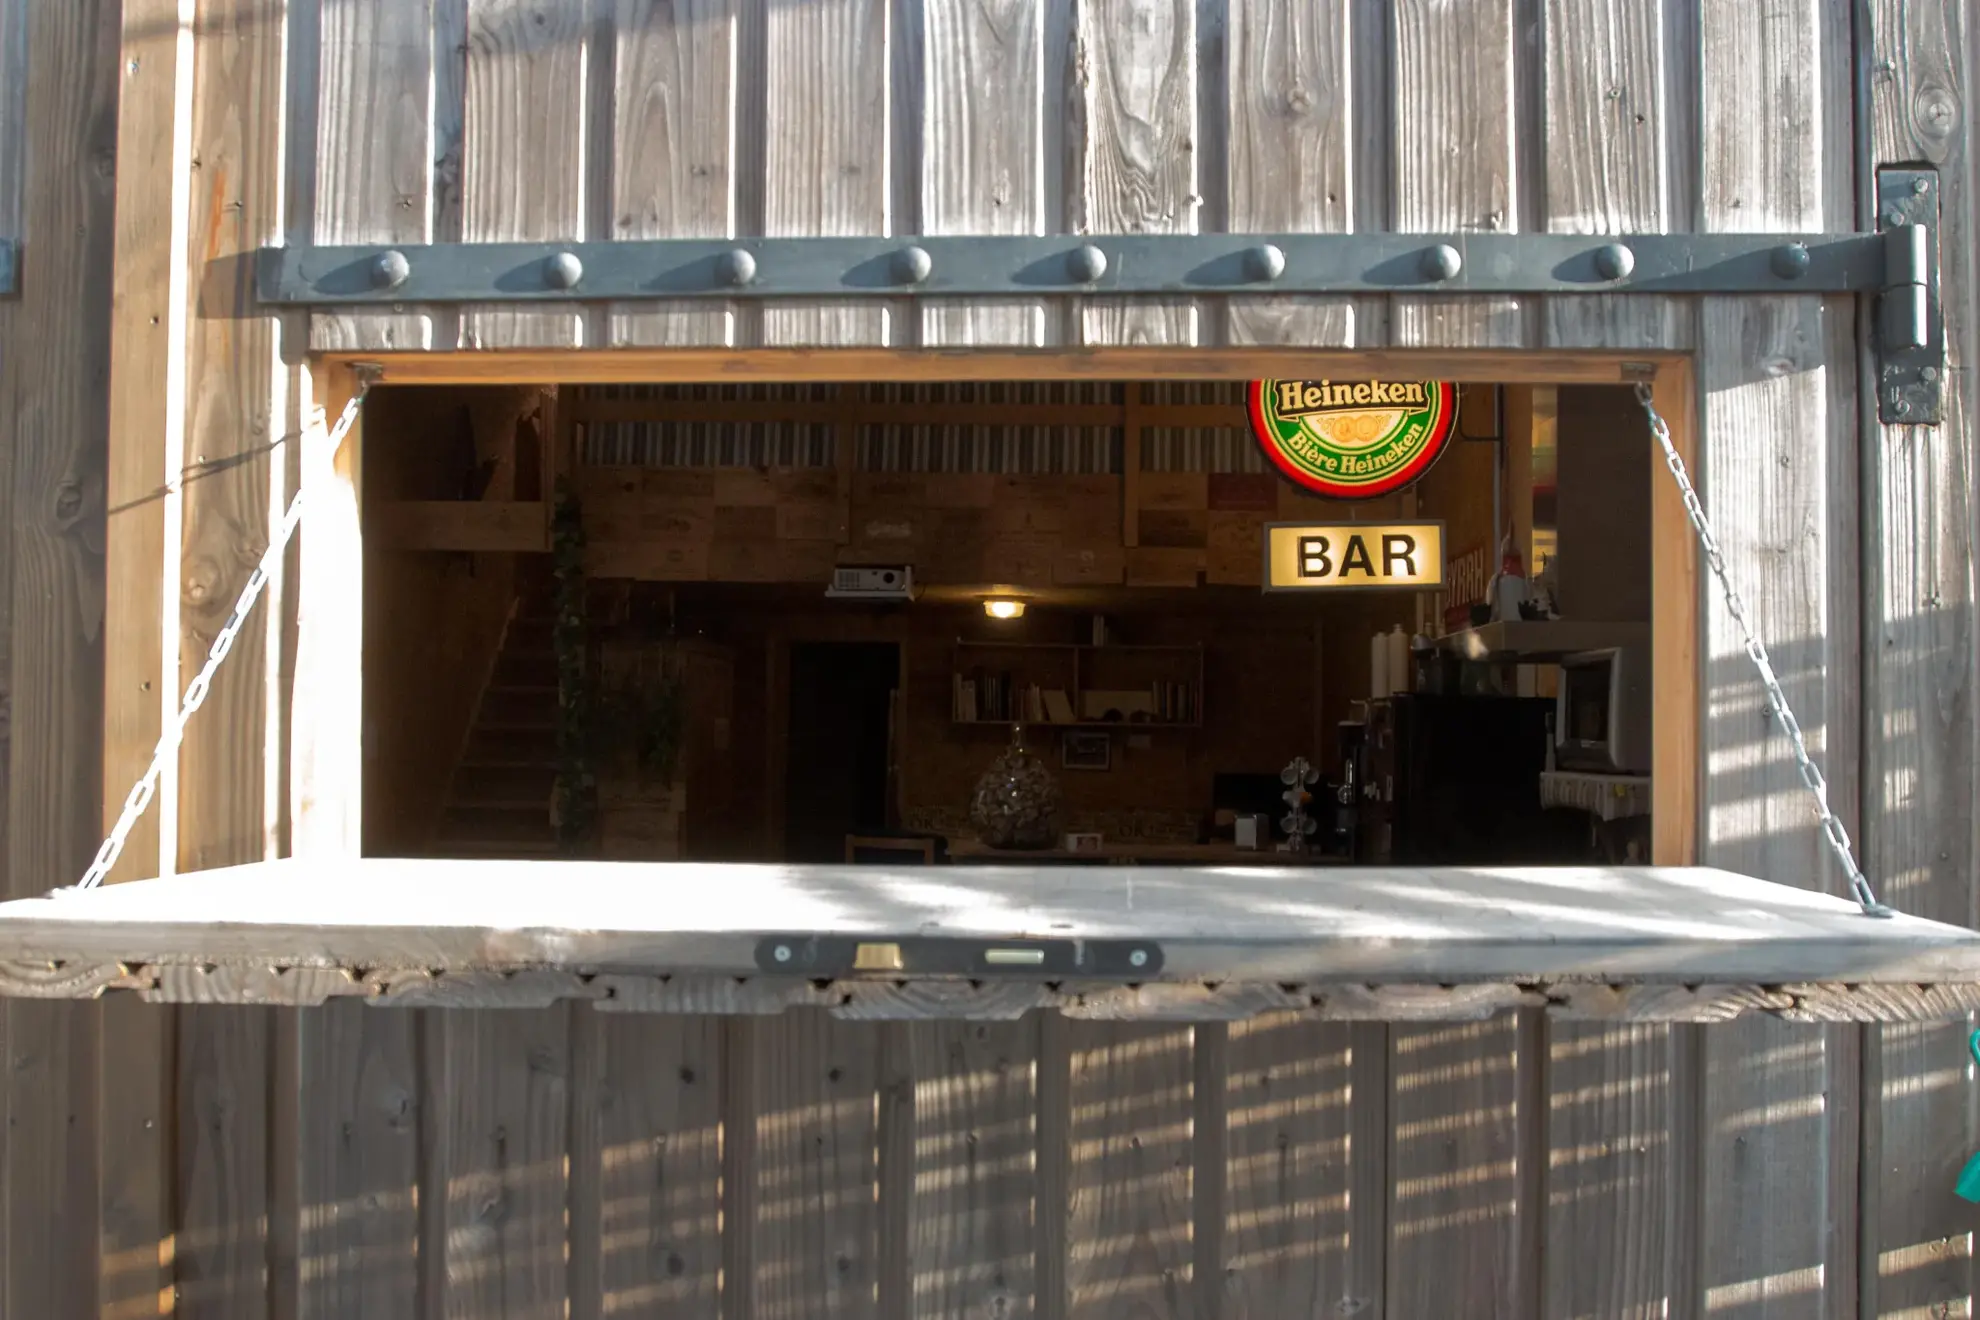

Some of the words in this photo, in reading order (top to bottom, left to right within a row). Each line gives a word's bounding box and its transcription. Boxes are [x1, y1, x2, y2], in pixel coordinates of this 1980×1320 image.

[1280, 379, 1424, 410] Heineken
[1288, 431, 1337, 472] Bière
[1340, 424, 1423, 474] Heineken
[1298, 534, 1416, 577] BAR
